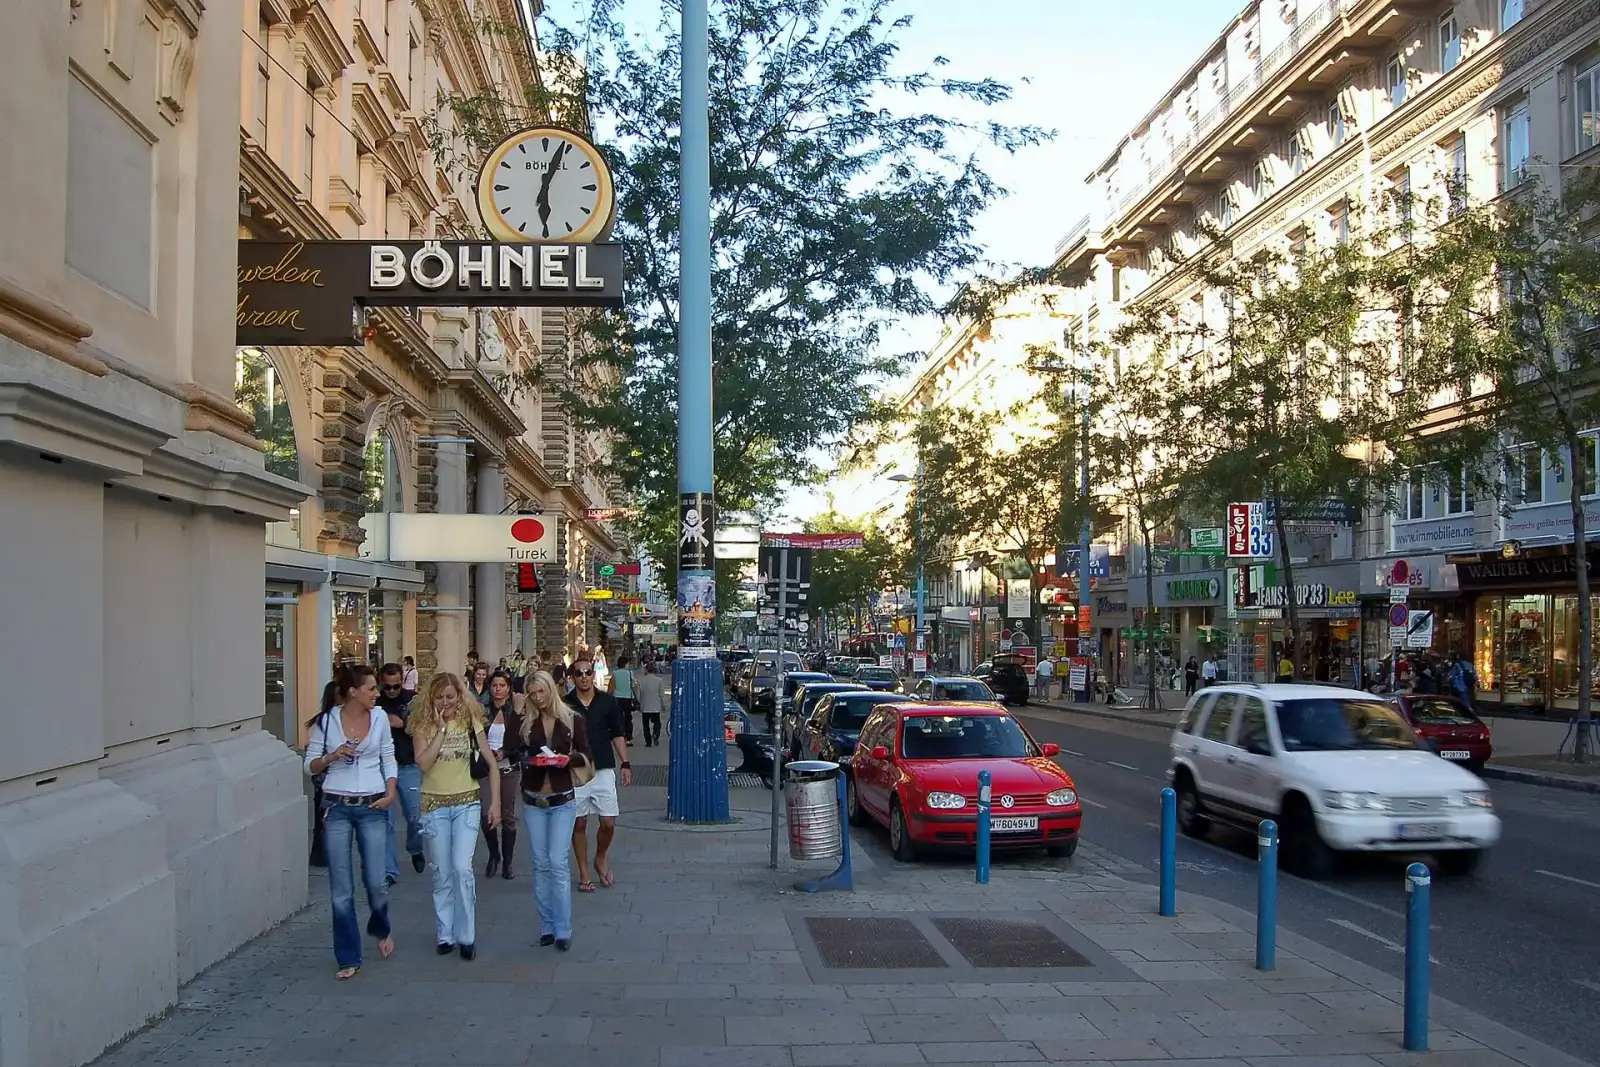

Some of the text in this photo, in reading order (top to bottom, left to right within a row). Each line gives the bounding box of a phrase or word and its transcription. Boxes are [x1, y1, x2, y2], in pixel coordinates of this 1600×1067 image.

[525, 160, 568, 171] BÖHEL
[237, 241, 325, 287] welen
[369, 240, 605, 290] BÖHNEL
[237, 294, 306, 331] hren
[1250, 526, 1272, 556] 33
[1396, 525, 1475, 545] www.immobilien.ne
[506, 546, 548, 560] Turek
[1386, 568, 1423, 587] cle's
[1468, 561, 1530, 578] WALTER
[1255, 585, 1283, 606] JEANS
[1284, 584, 1309, 606] SOP
[1310, 583, 1323, 605] 33
[1328, 586, 1355, 605] Lee
